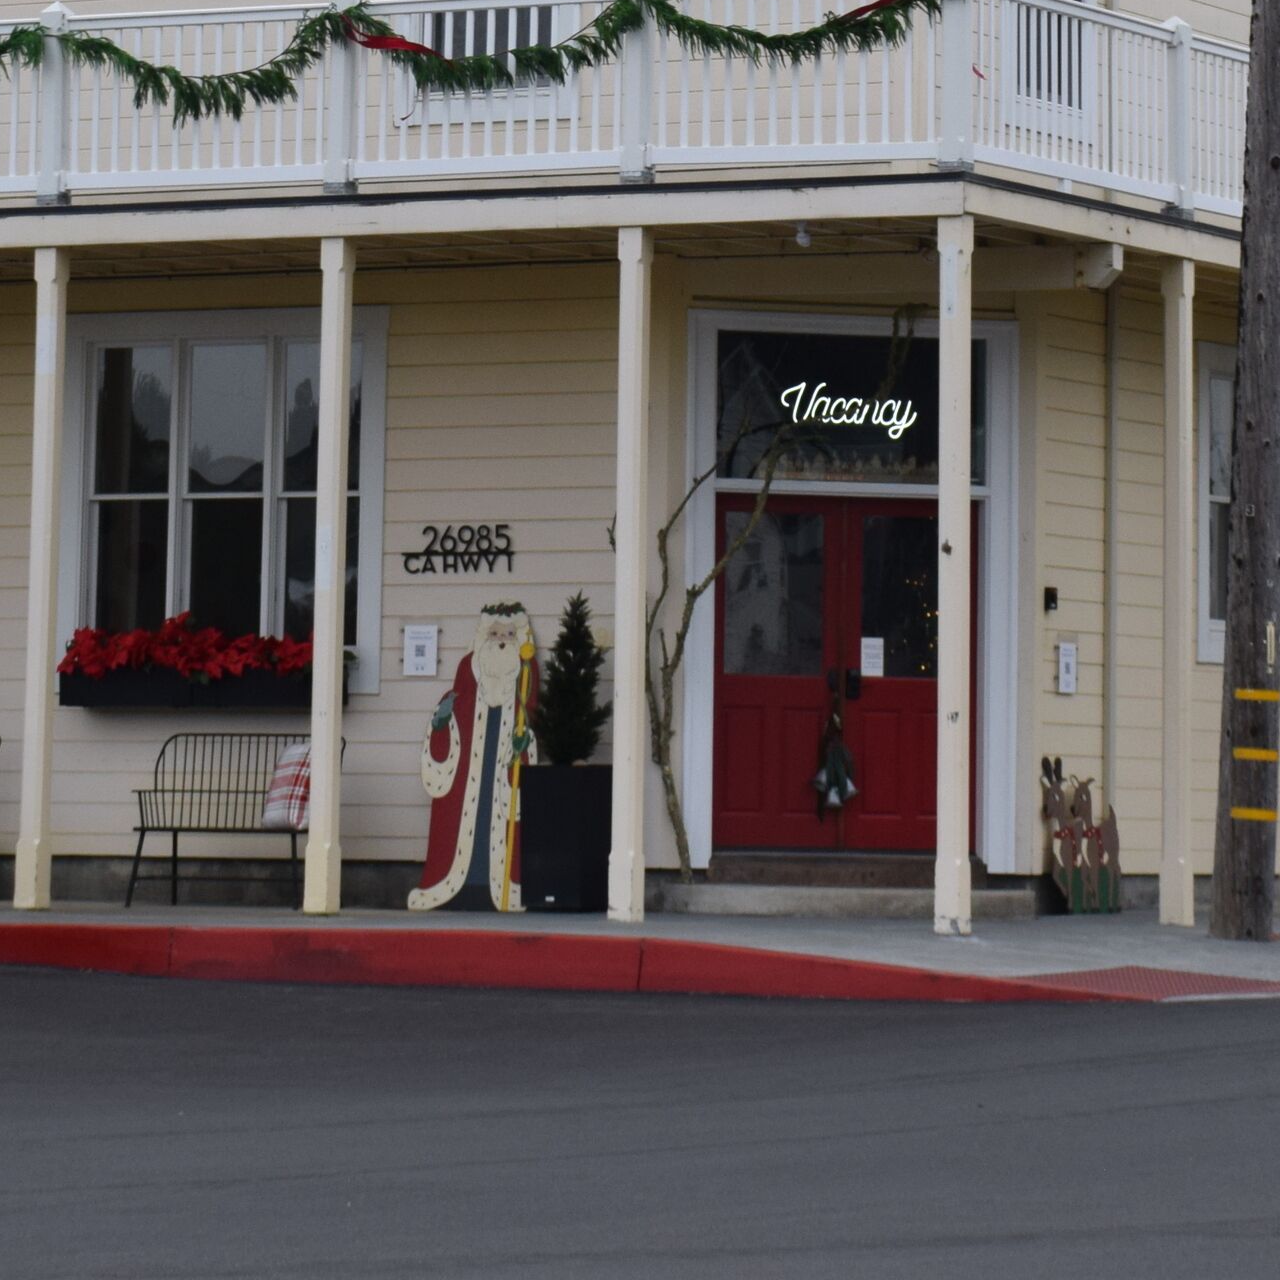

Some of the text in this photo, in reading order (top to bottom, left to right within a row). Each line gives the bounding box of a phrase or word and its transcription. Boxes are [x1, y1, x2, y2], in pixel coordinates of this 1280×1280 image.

[780, 381, 918, 440] Vacancy
[421, 523, 512, 554] 26985
[403, 554, 437, 575] CA
